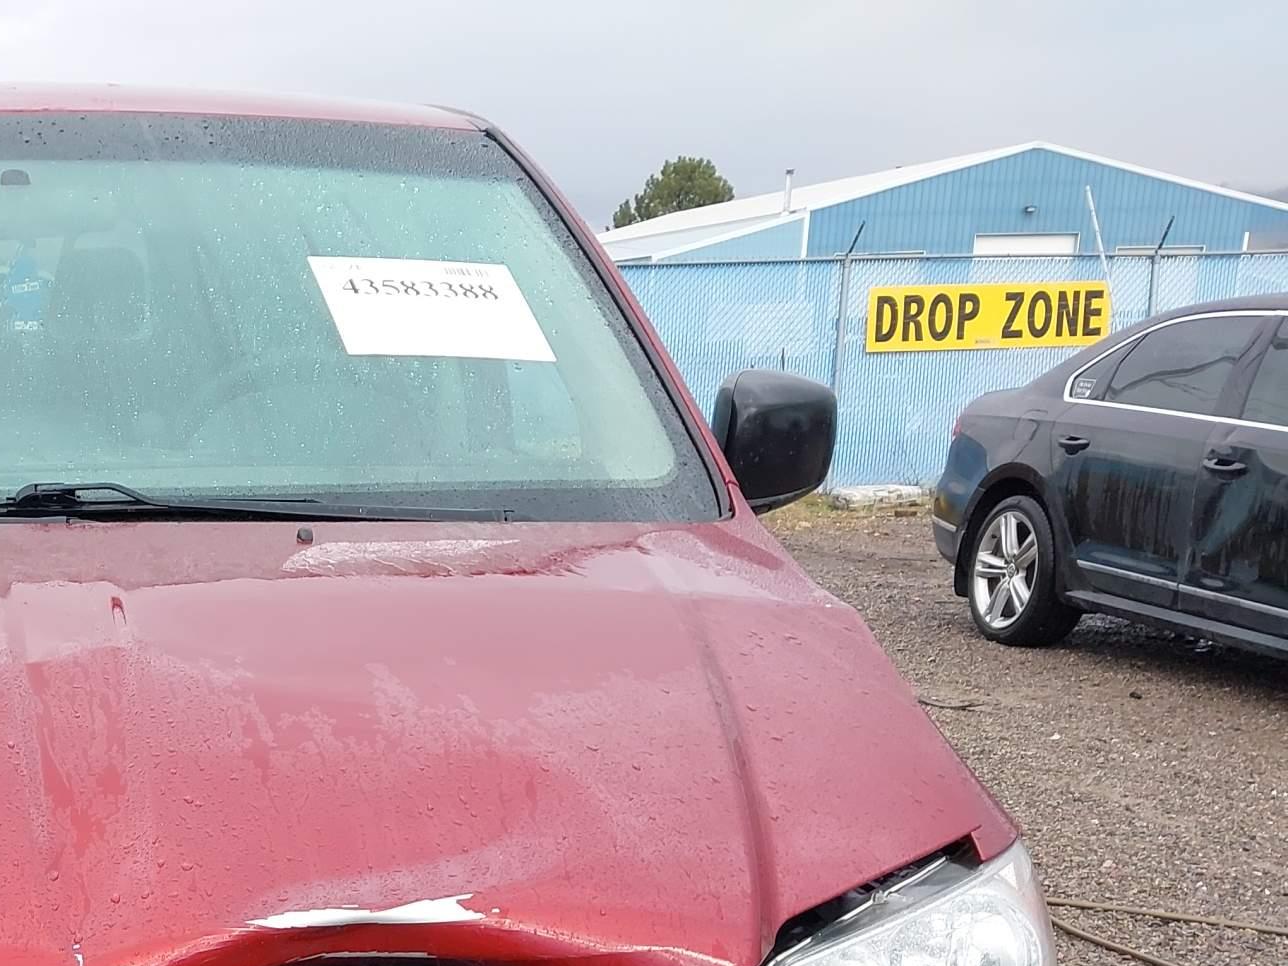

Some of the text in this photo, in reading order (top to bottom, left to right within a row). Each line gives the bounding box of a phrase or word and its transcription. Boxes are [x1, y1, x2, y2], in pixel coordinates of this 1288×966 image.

[342, 278, 499, 300] 43583388
[875, 290, 1104, 342] DROP ZONE
